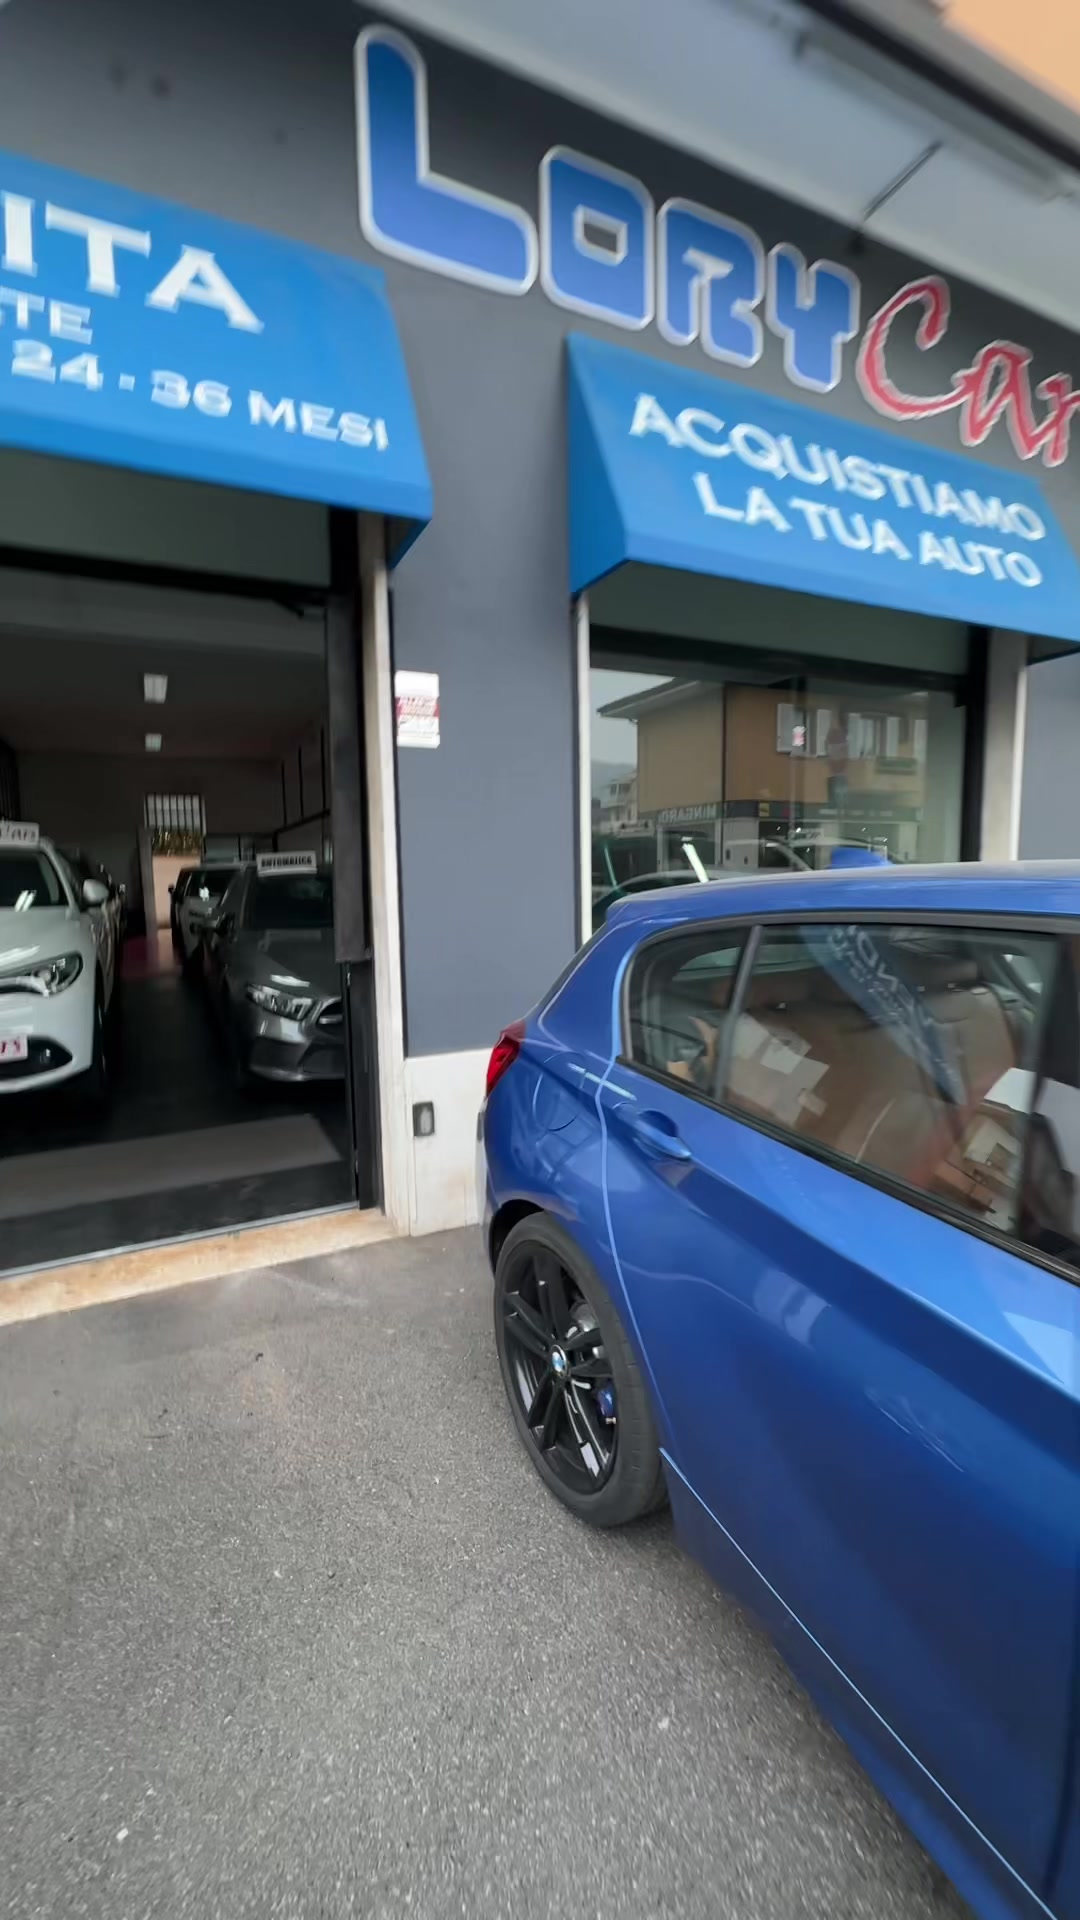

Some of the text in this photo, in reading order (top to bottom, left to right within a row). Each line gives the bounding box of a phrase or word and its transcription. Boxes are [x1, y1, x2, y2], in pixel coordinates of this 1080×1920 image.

[1, 190, 264, 334] ITA
[11, 339, 104, 392] 24
[150, 369, 232, 418] 36
[248, 389, 389, 452] MESI
[628, 392, 1047, 542] ACQUISTIAMO
[693, 472, 1043, 588] LA TUA AUTO
